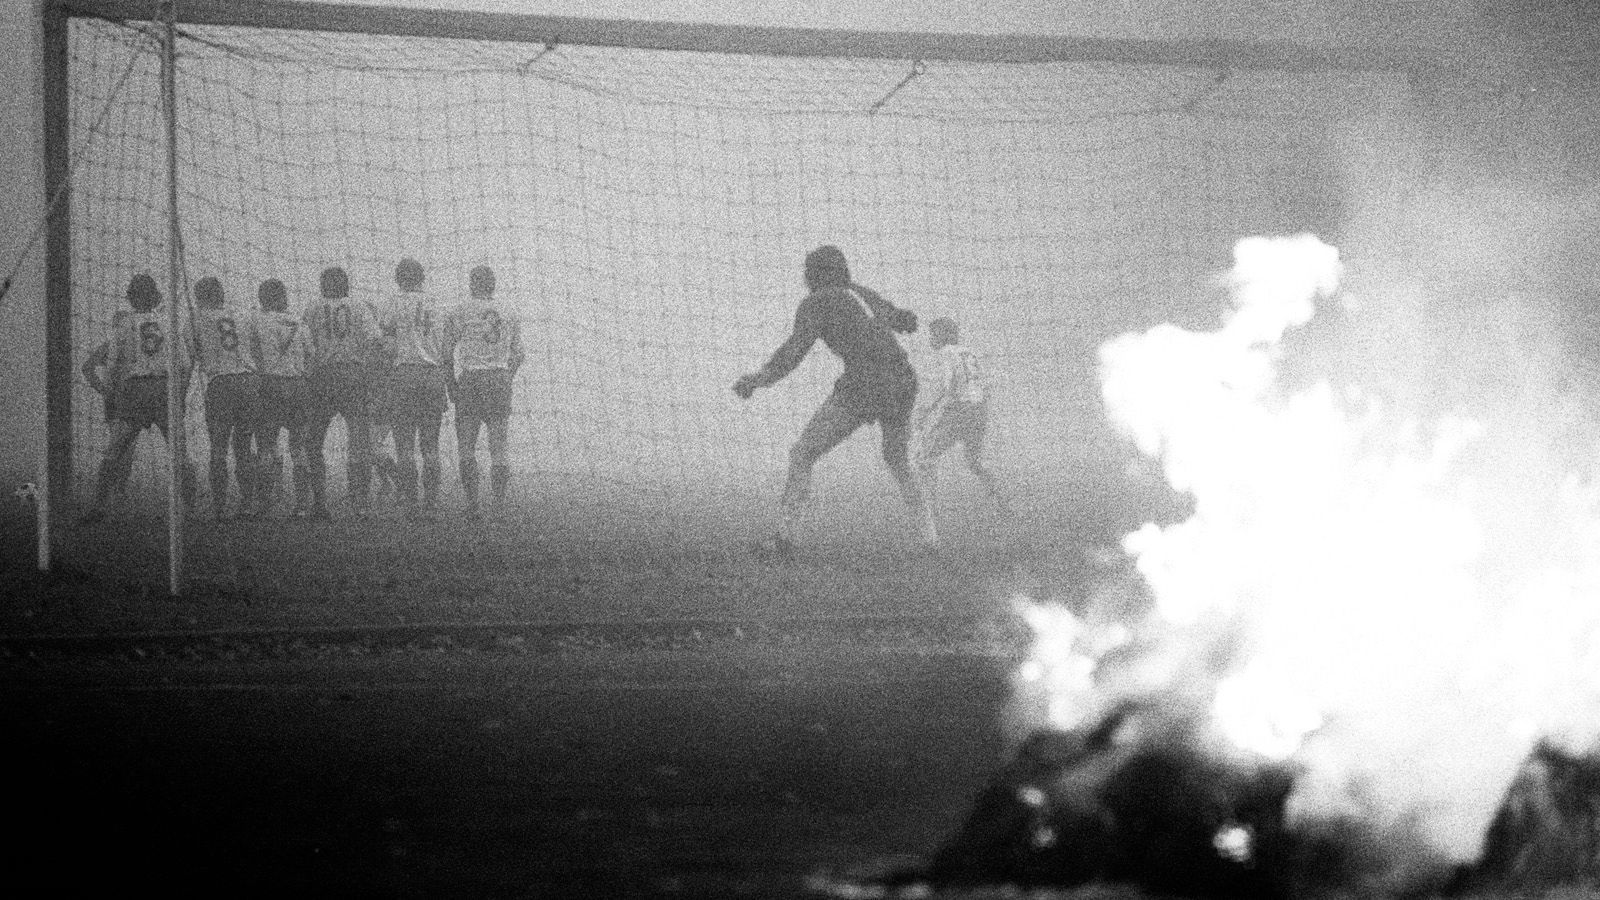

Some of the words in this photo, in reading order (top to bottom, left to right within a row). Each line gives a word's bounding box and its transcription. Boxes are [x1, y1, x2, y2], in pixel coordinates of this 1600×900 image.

[217, 317, 240, 351] 8
[278, 319, 299, 355] 7
[322, 303, 351, 339] 10
[413, 301, 434, 337] 4
[481, 309, 502, 345] 3
[140, 321, 164, 356] 6
